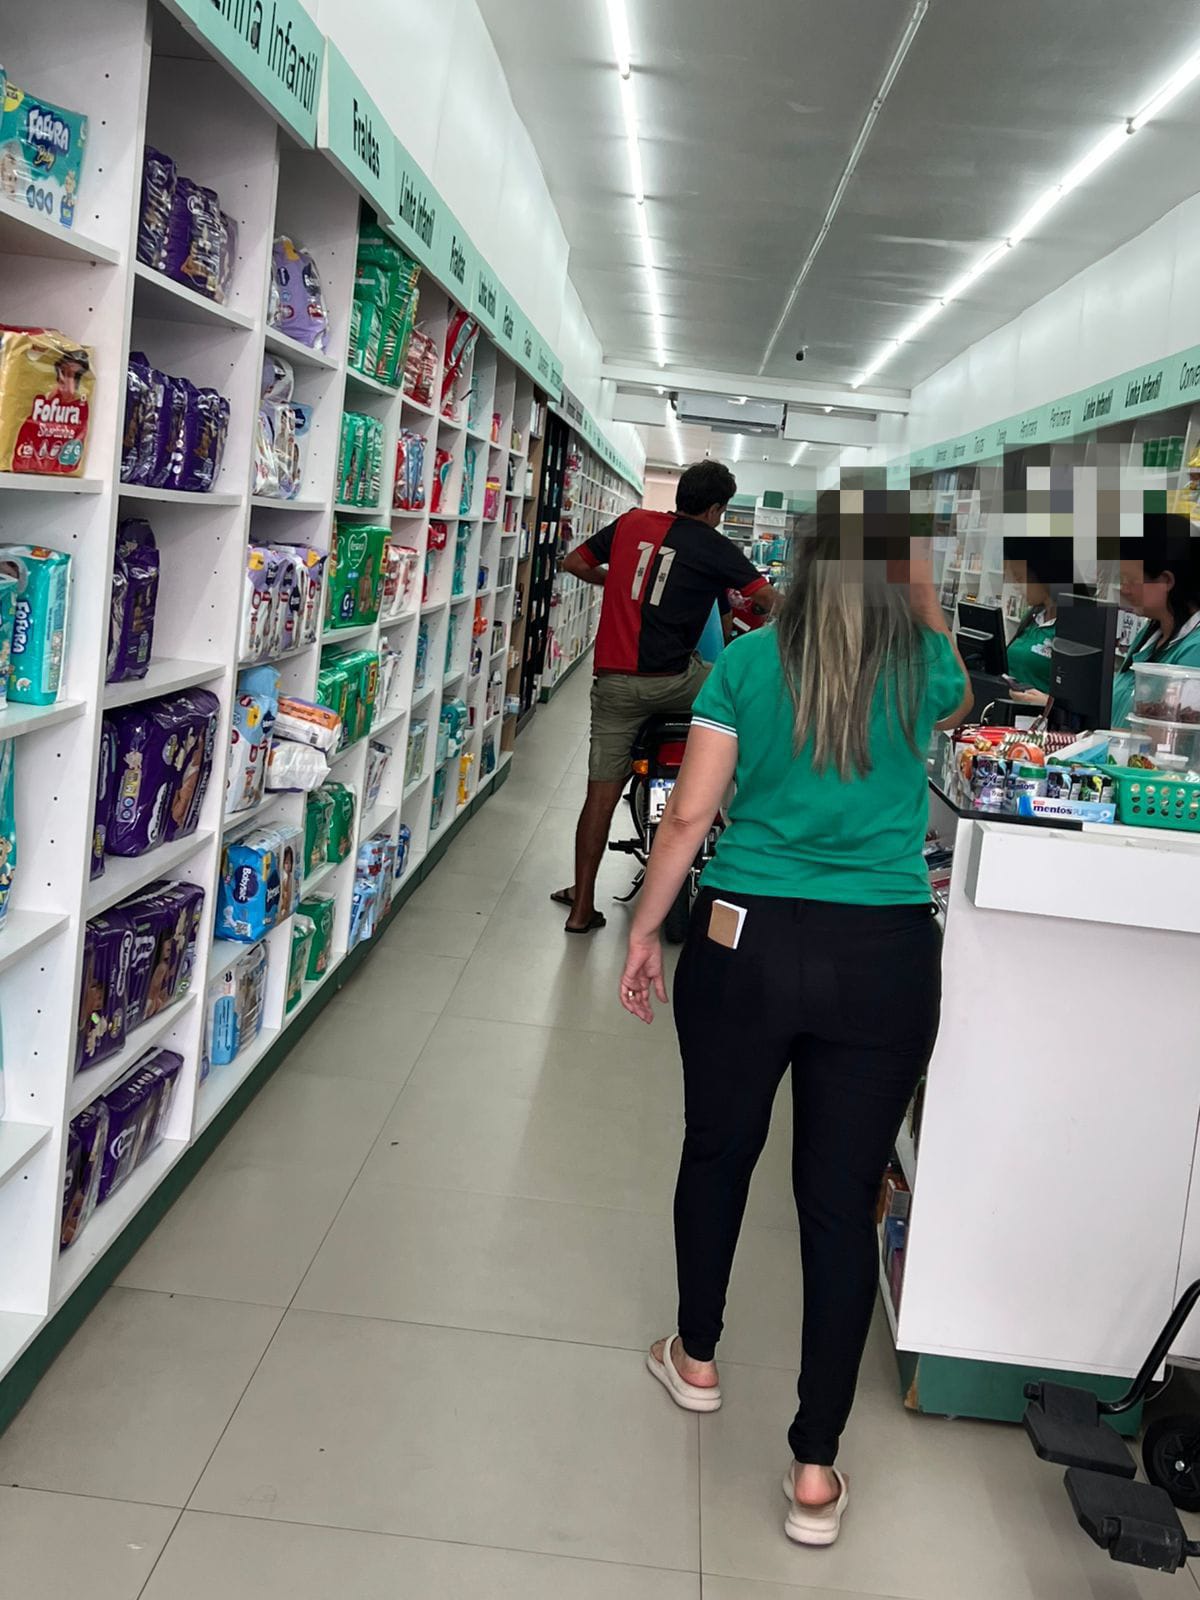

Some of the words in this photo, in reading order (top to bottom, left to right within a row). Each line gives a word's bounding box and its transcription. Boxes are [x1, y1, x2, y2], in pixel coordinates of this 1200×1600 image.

[267, 2, 318, 115] Infantil
[28, 109, 69, 150] FOFURA
[353, 98, 380, 180] Fraldas
[33, 398, 81, 425] Fofura
[631, 541, 677, 607] 11
[13, 601, 31, 653] FOFURA
[1033, 805, 1072, 815] mentos
[238, 867, 252, 901] Babysec
